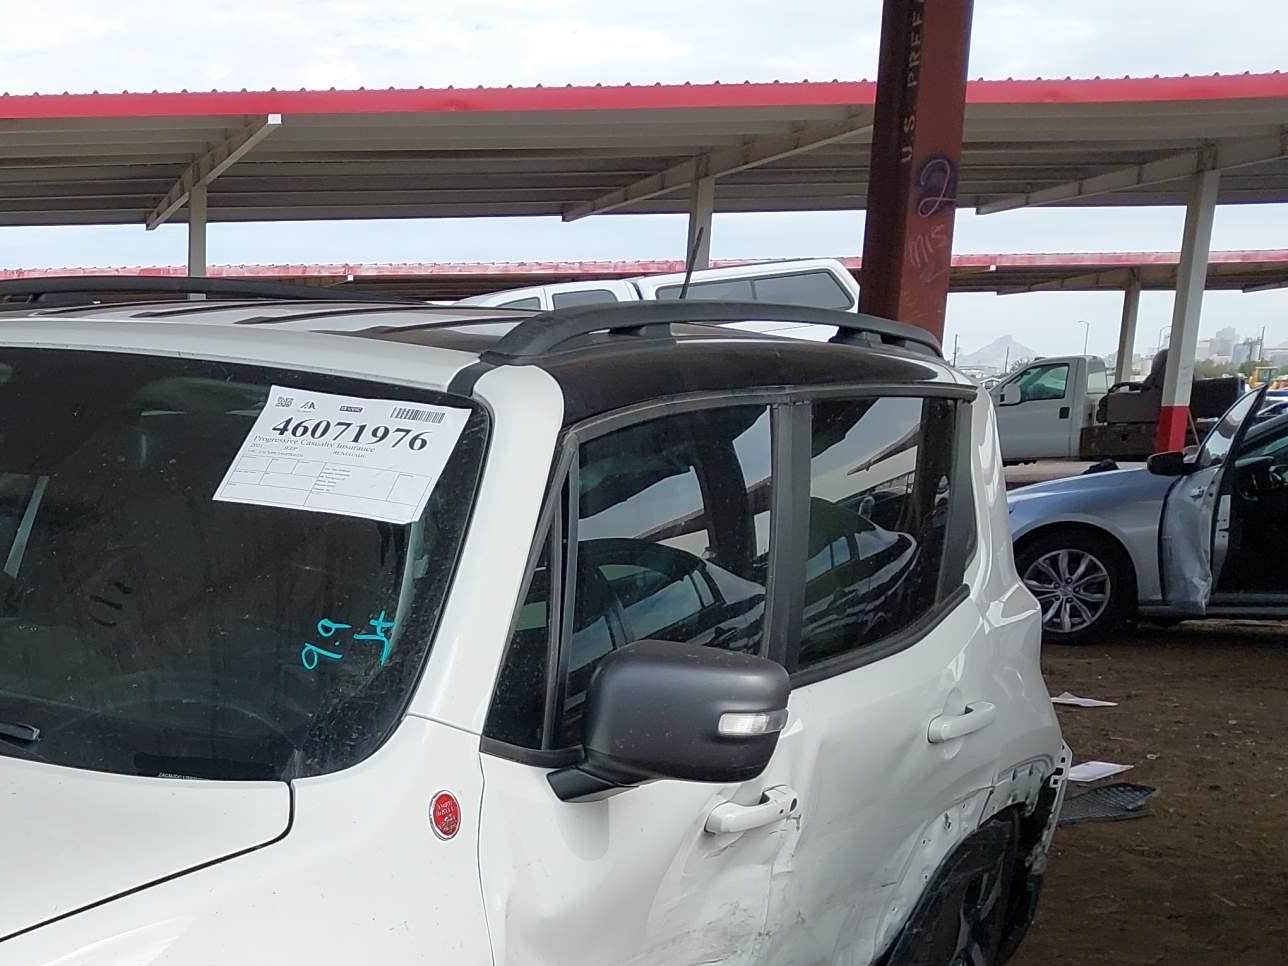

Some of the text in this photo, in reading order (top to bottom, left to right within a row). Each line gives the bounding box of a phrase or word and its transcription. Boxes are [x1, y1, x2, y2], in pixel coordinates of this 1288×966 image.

[918, 158, 958, 217] 2
[253, 434, 376, 453] Progressive Casualty Insurance
[271, 416, 433, 451] 46071976
